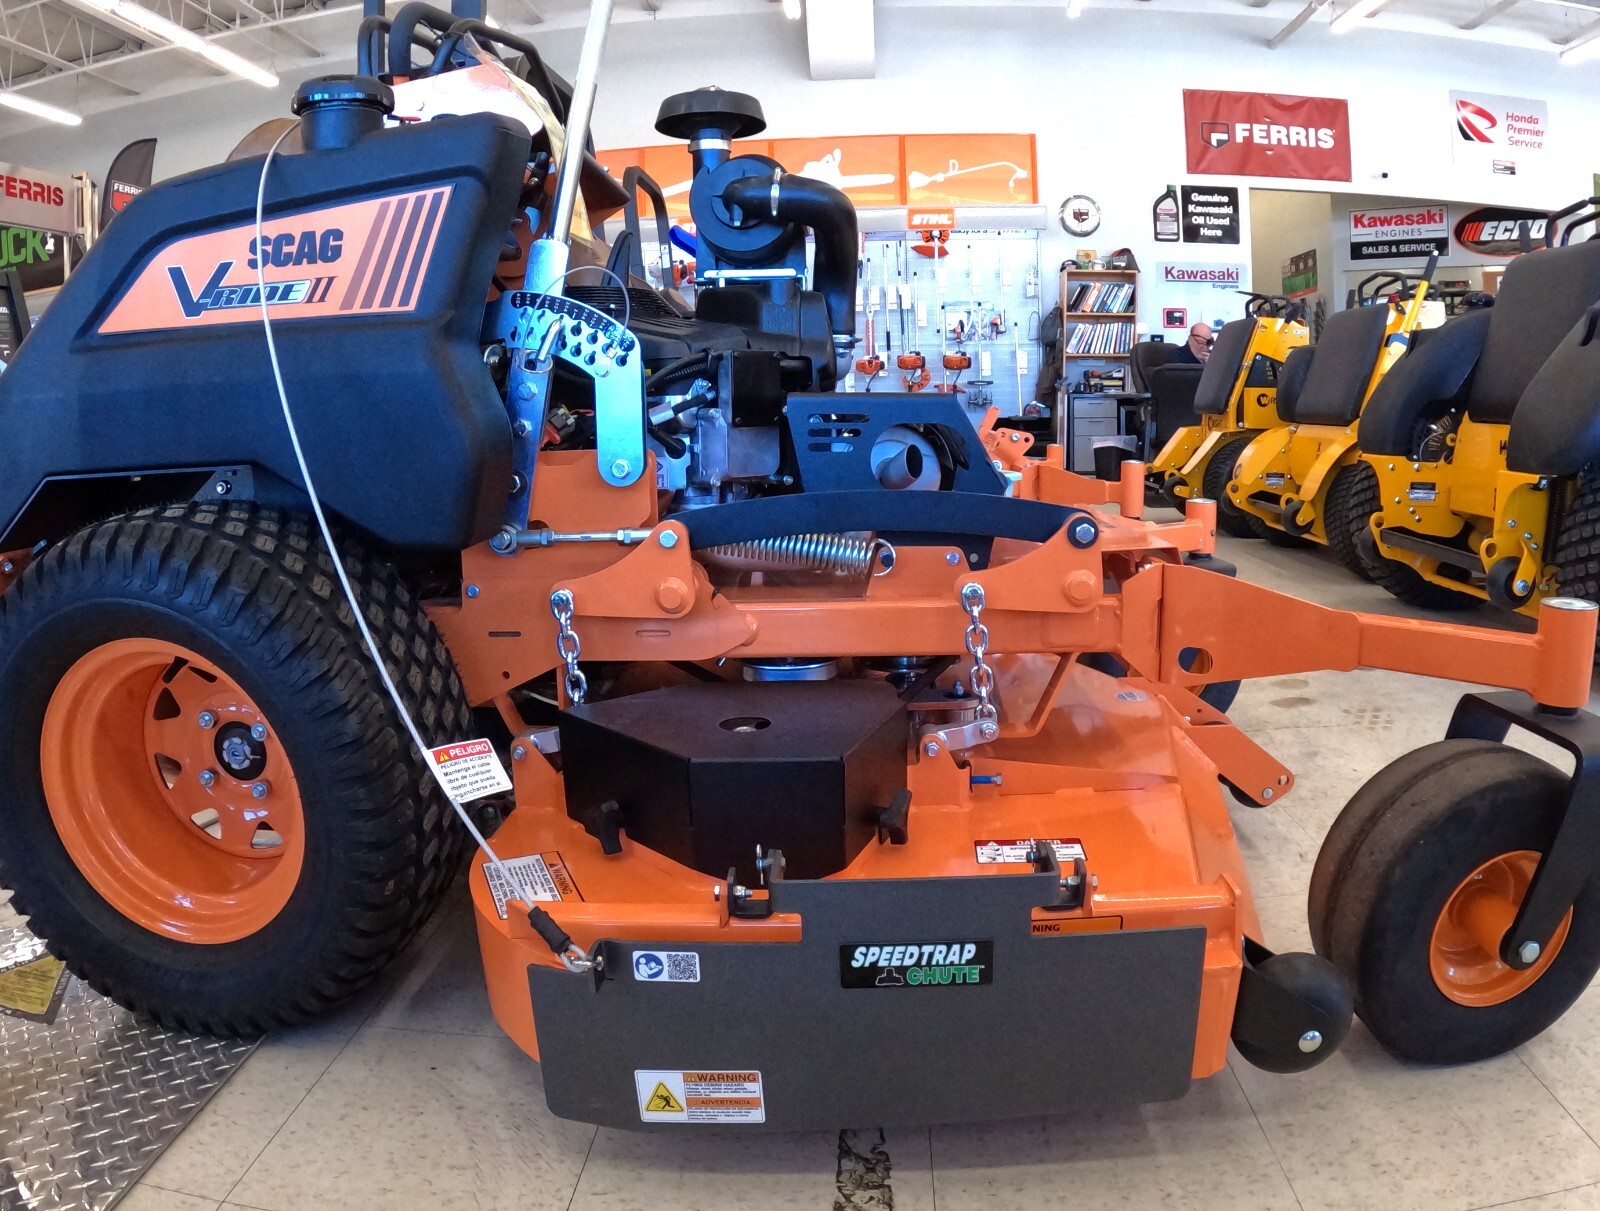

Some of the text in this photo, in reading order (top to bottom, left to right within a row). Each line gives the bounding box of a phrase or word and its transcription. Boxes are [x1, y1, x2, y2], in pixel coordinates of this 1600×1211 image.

[1505, 112, 1540, 125] Honda
[1235, 123, 1335, 149] FERRIS
[1506, 123, 1545, 137] Premier
[1507, 136, 1543, 149] Service
[1191, 193, 1229, 203] Genuine
[1188, 204, 1233, 214] Kawasaki
[911, 213, 952, 226] STIHL
[1191, 215, 1230, 226] Oil Used
[1353, 208, 1444, 229] Kawasaki
[1200, 227, 1222, 237] Here
[1375, 228, 1422, 239] ENGINES
[247, 228, 344, 270] SCAG
[1362, 242, 1437, 255] SALES & SERVICE
[1164, 265, 1239, 281] Kawasaki
[449, 743, 489, 757] PELIGRO
[1016, 839, 1062, 847] DAER
[552, 868, 573, 895] WARNING
[851, 943, 977, 968] SPEEDTRAP
[907, 965, 980, 985] CHUTE
[697, 1073, 757, 1082] WARNING
